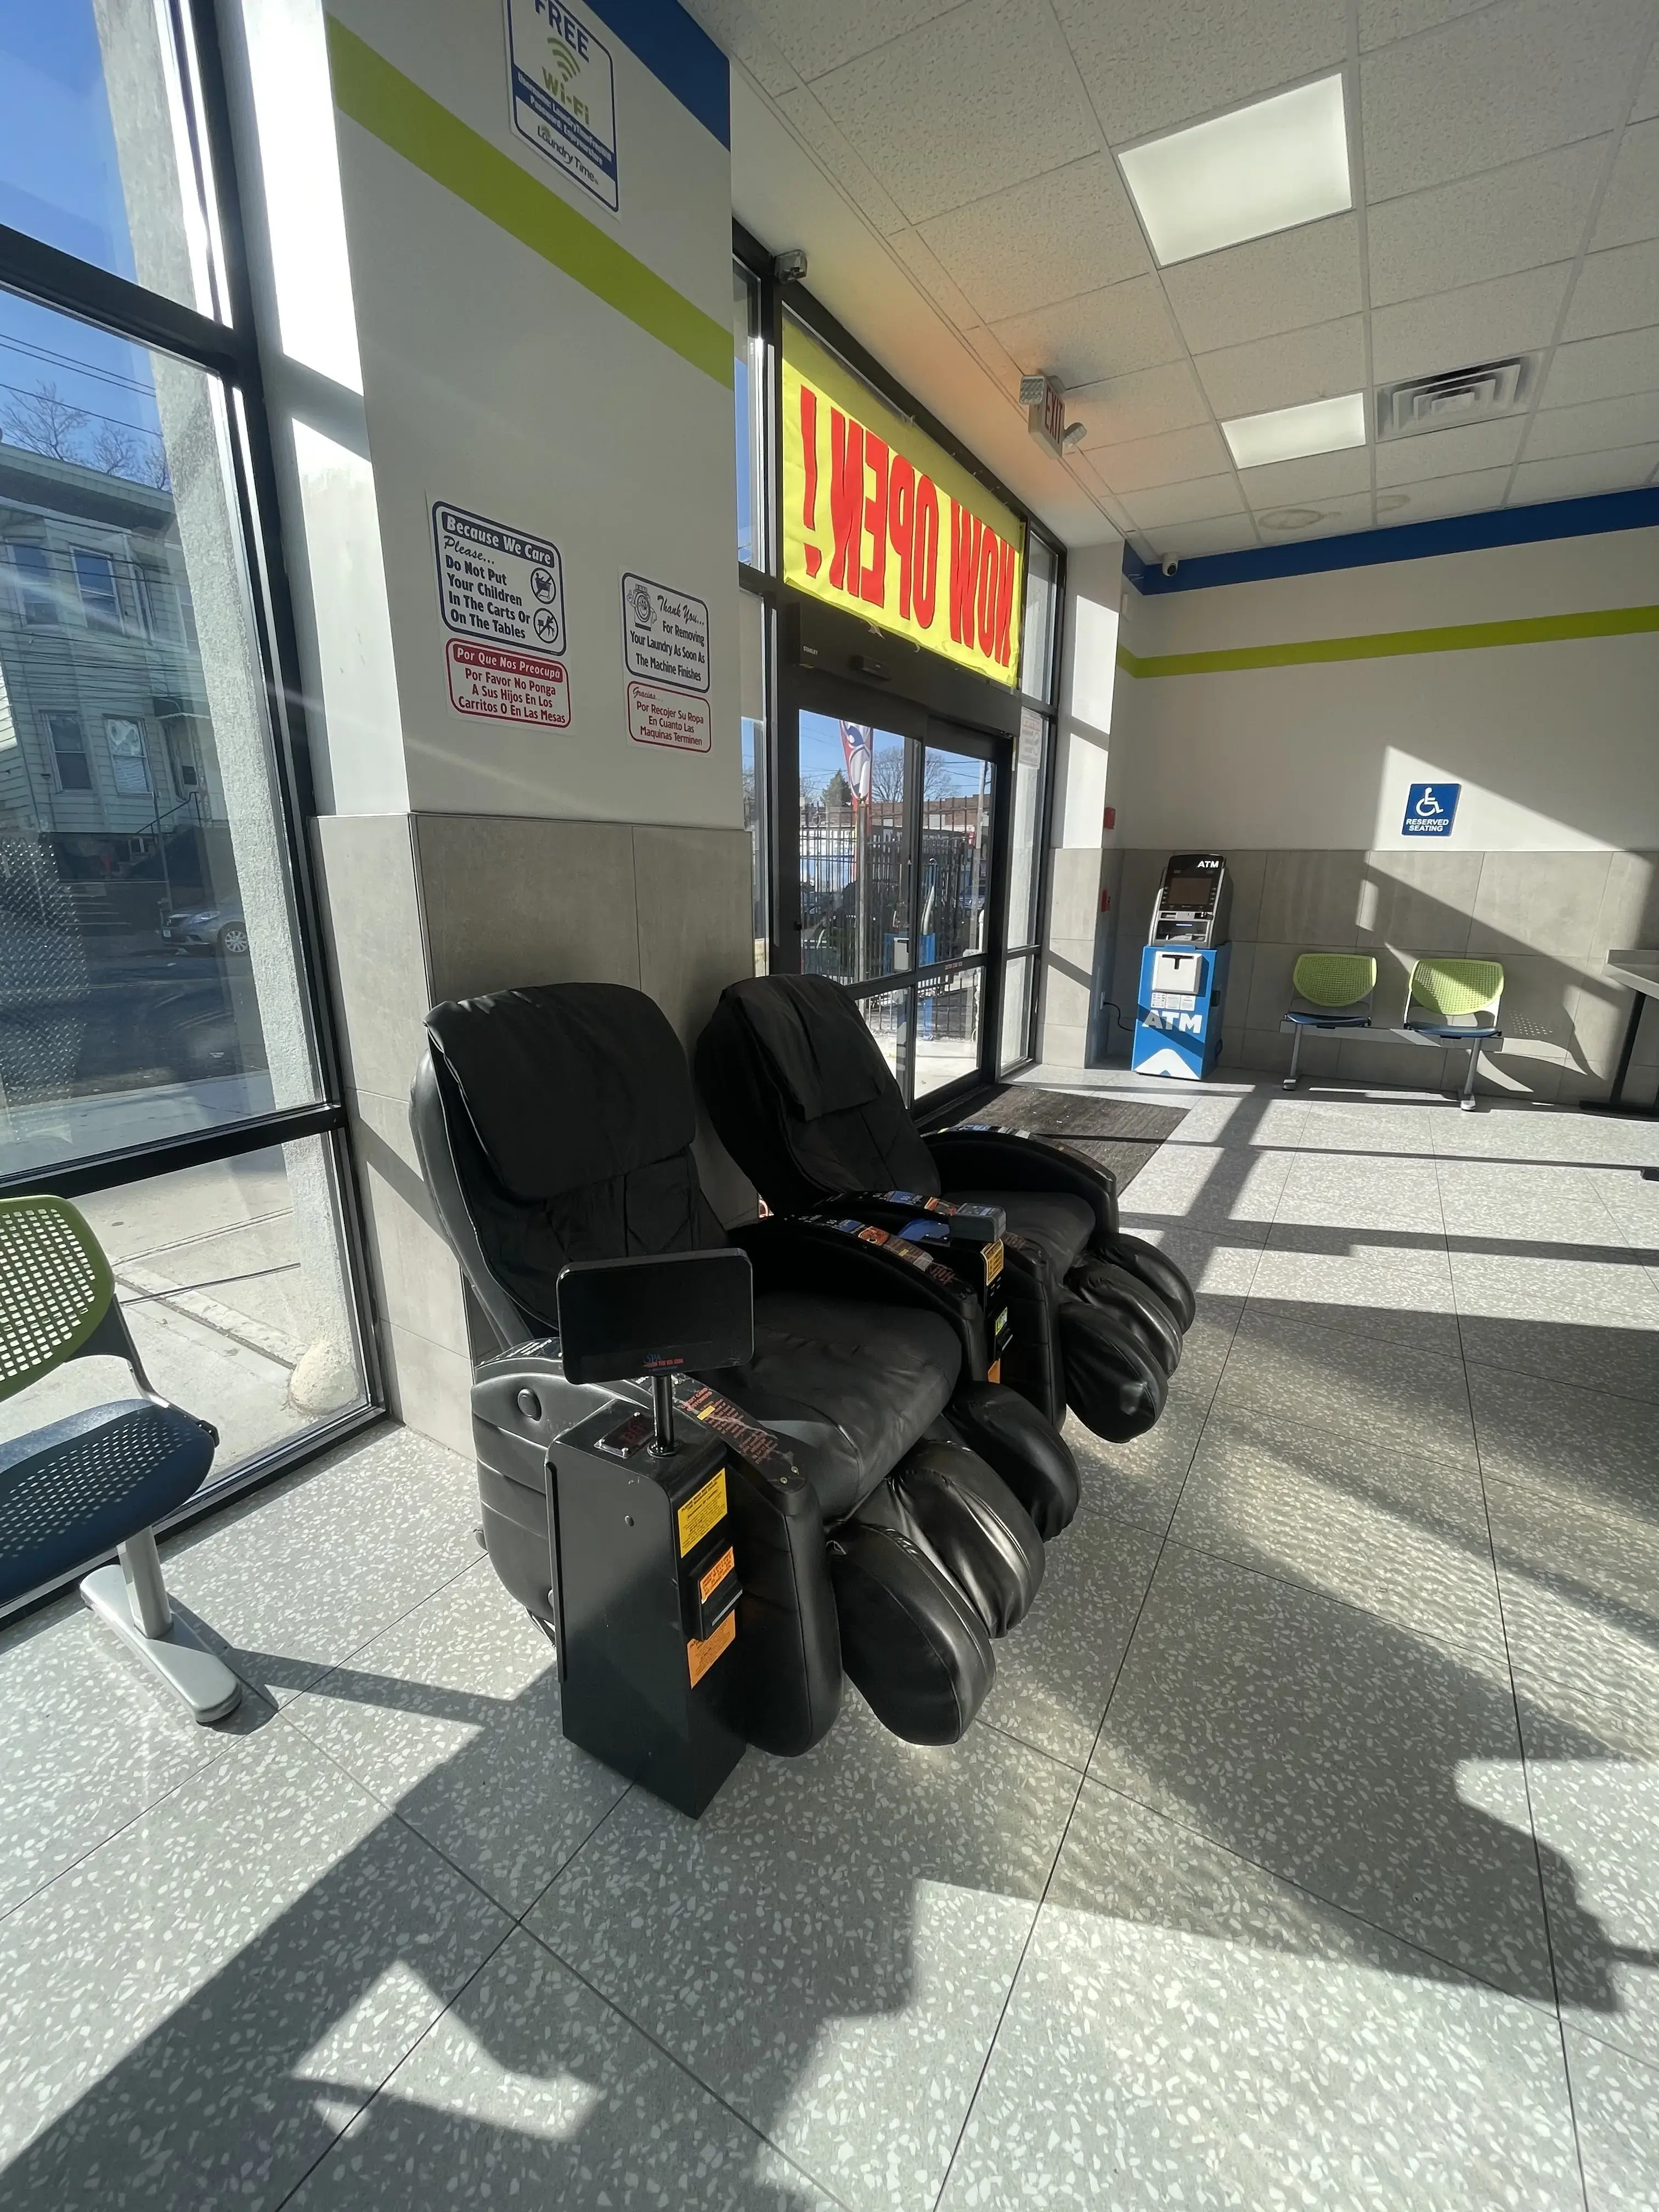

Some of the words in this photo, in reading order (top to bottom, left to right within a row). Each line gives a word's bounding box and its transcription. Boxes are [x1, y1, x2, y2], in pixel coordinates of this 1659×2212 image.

[537, 125, 573, 164] Laundry
[574, 156, 595, 182] Time
[1045, 385, 1063, 444] EXIT
[444, 535, 494, 565] Please...
[447, 515, 499, 546] Because
[503, 535, 521, 555] We
[524, 544, 551, 565] Care
[445, 554, 461, 572] Do
[464, 560, 485, 579] Not
[488, 568, 507, 586] Put
[447, 572, 474, 592] Your
[477, 582, 522, 607] Children
[448, 590, 461, 606] In
[463, 595, 484, 612] The
[487, 601, 516, 620] Carts
[518, 610, 531, 624] Or
[657, 595, 681, 617] Thank
[683, 604, 704, 626] You...
[450, 608, 467, 625] On
[469, 613, 490, 630] The
[492, 619, 526, 639] Tables
[663, 620, 674, 635] For
[675, 624, 704, 647] Removing
[457, 647, 475, 661] Por
[478, 652, 497, 666] Que
[500, 656, 516, 670] Nos
[630, 630, 646, 646] Your
[647, 635, 673, 657] Laundry
[674, 644, 681, 657] As
[682, 646, 697, 662] Soon
[698, 651, 705, 664] As
[465, 667, 483, 681] Por
[486, 671, 511, 687] Favor
[514, 677, 527, 690] No
[529, 680, 556, 697] Ponga
[635, 652, 648, 668] The
[650, 656, 676, 675] Machine
[678, 664, 701, 682] Finishes
[458, 696, 498, 713] Carritos
[500, 703, 507, 714] O
[510, 704, 521, 716] En
[524, 707, 538, 719] Las
[540, 709, 566, 723] Mesas
[472, 684, 479, 696] A
[482, 685, 498, 699] Sus
[500, 689, 523, 704] Hijos
[525, 693, 536, 706] En
[538, 696, 553, 708] Los
[636, 701, 649, 713] Por
[651, 703, 676, 719] Recojer
[678, 710, 686, 720] Su
[688, 712, 704, 725] Ropa
[648, 715, 657, 726] En
[659, 718, 682, 731] Cuanto
[684, 723, 695, 733] Las
[640, 725, 673, 740] Maquinas
[673, 732, 702, 746] Terminen
[1142, 1009, 1203, 1034] ATM
